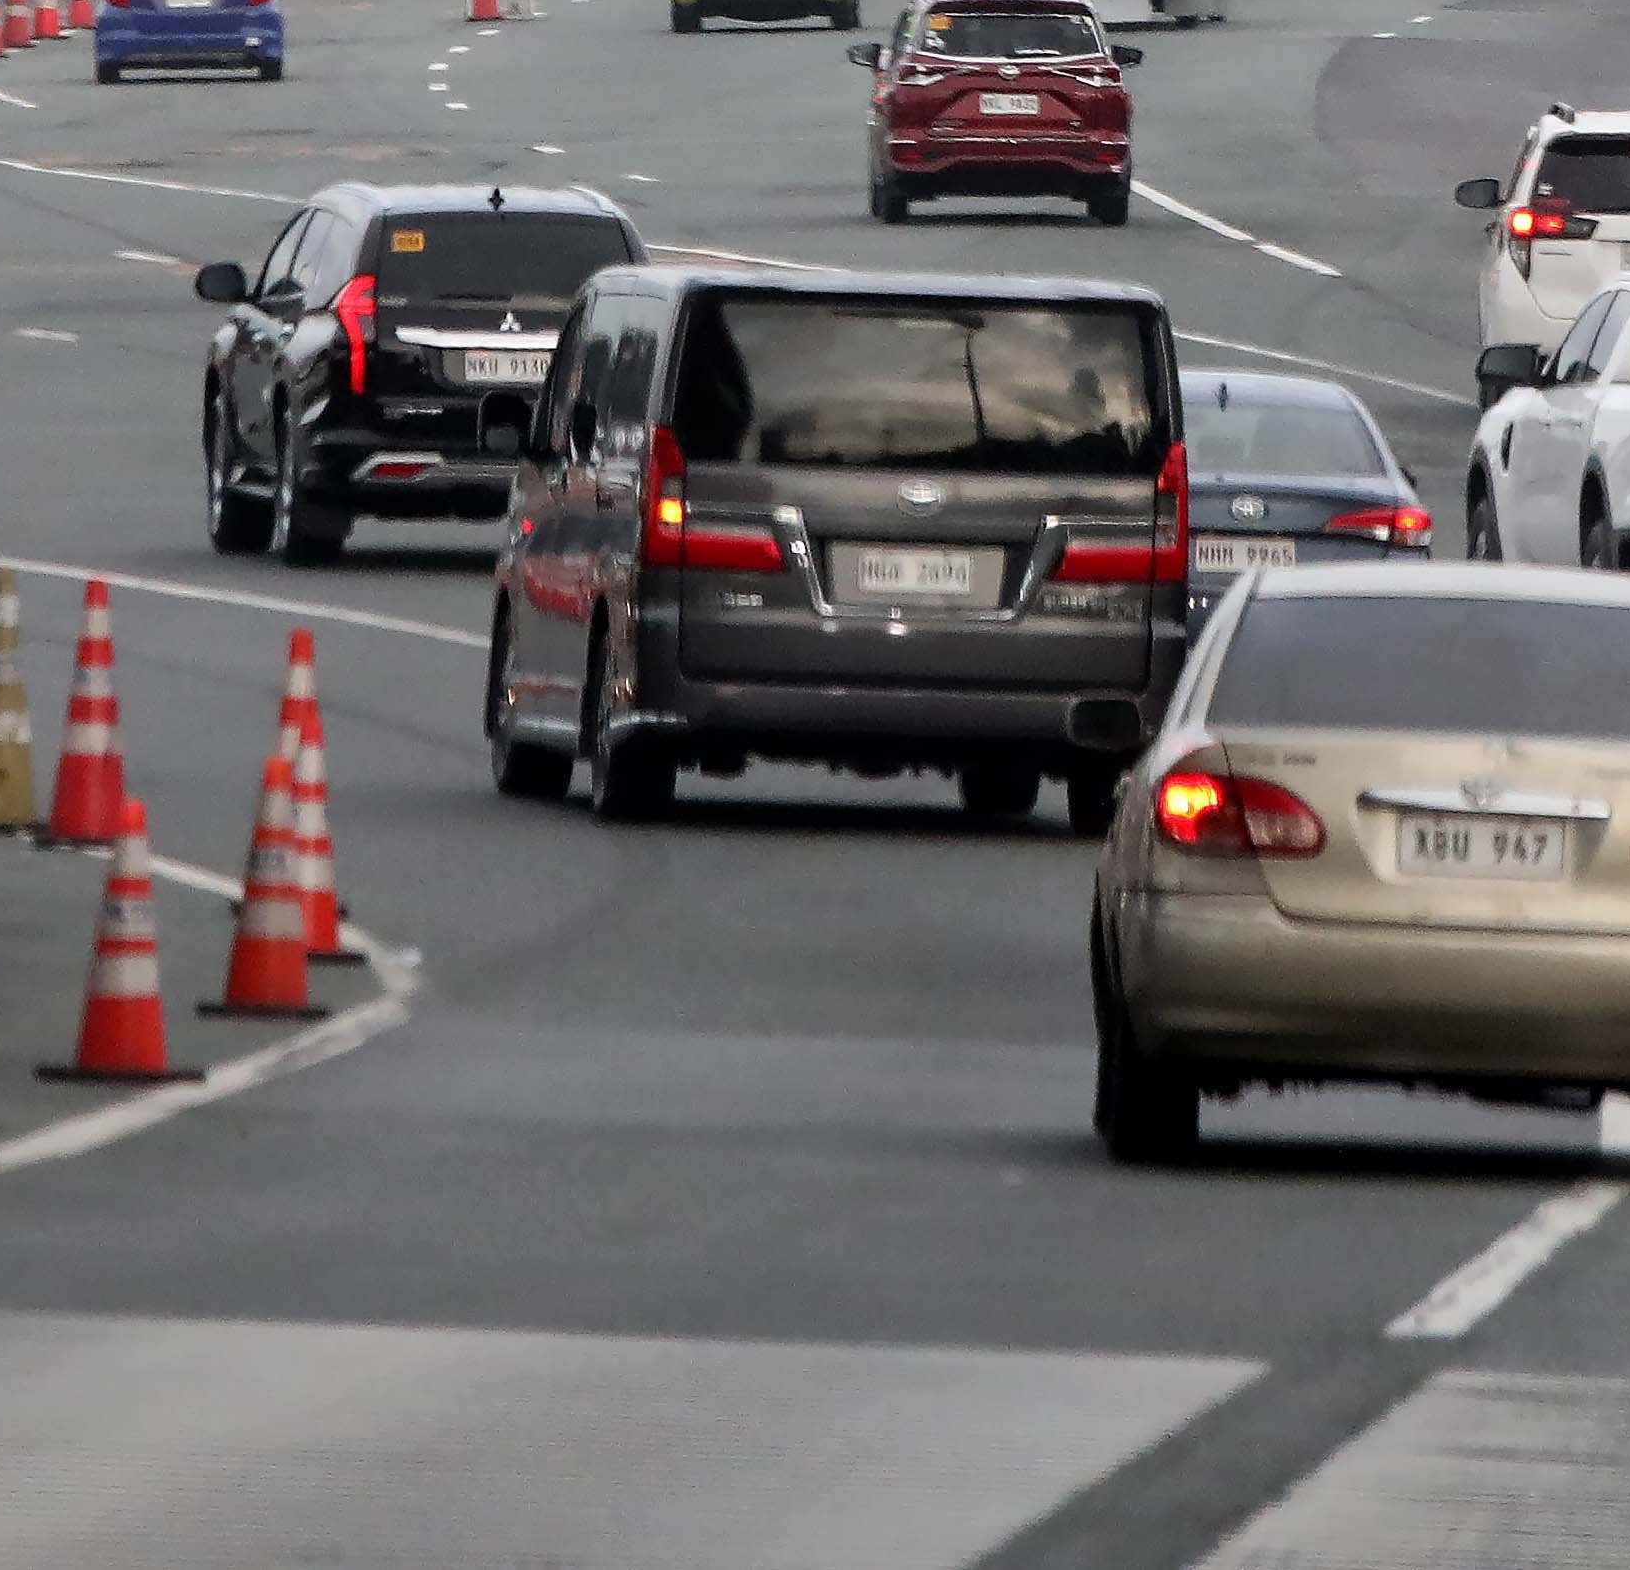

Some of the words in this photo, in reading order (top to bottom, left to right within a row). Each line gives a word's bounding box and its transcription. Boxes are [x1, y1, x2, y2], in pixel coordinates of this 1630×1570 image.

[466, 358, 498, 373] NKU
[509, 358, 550, 373] 9130
[1246, 545, 1293, 563] 9965
[1491, 830, 1548, 865] 947
